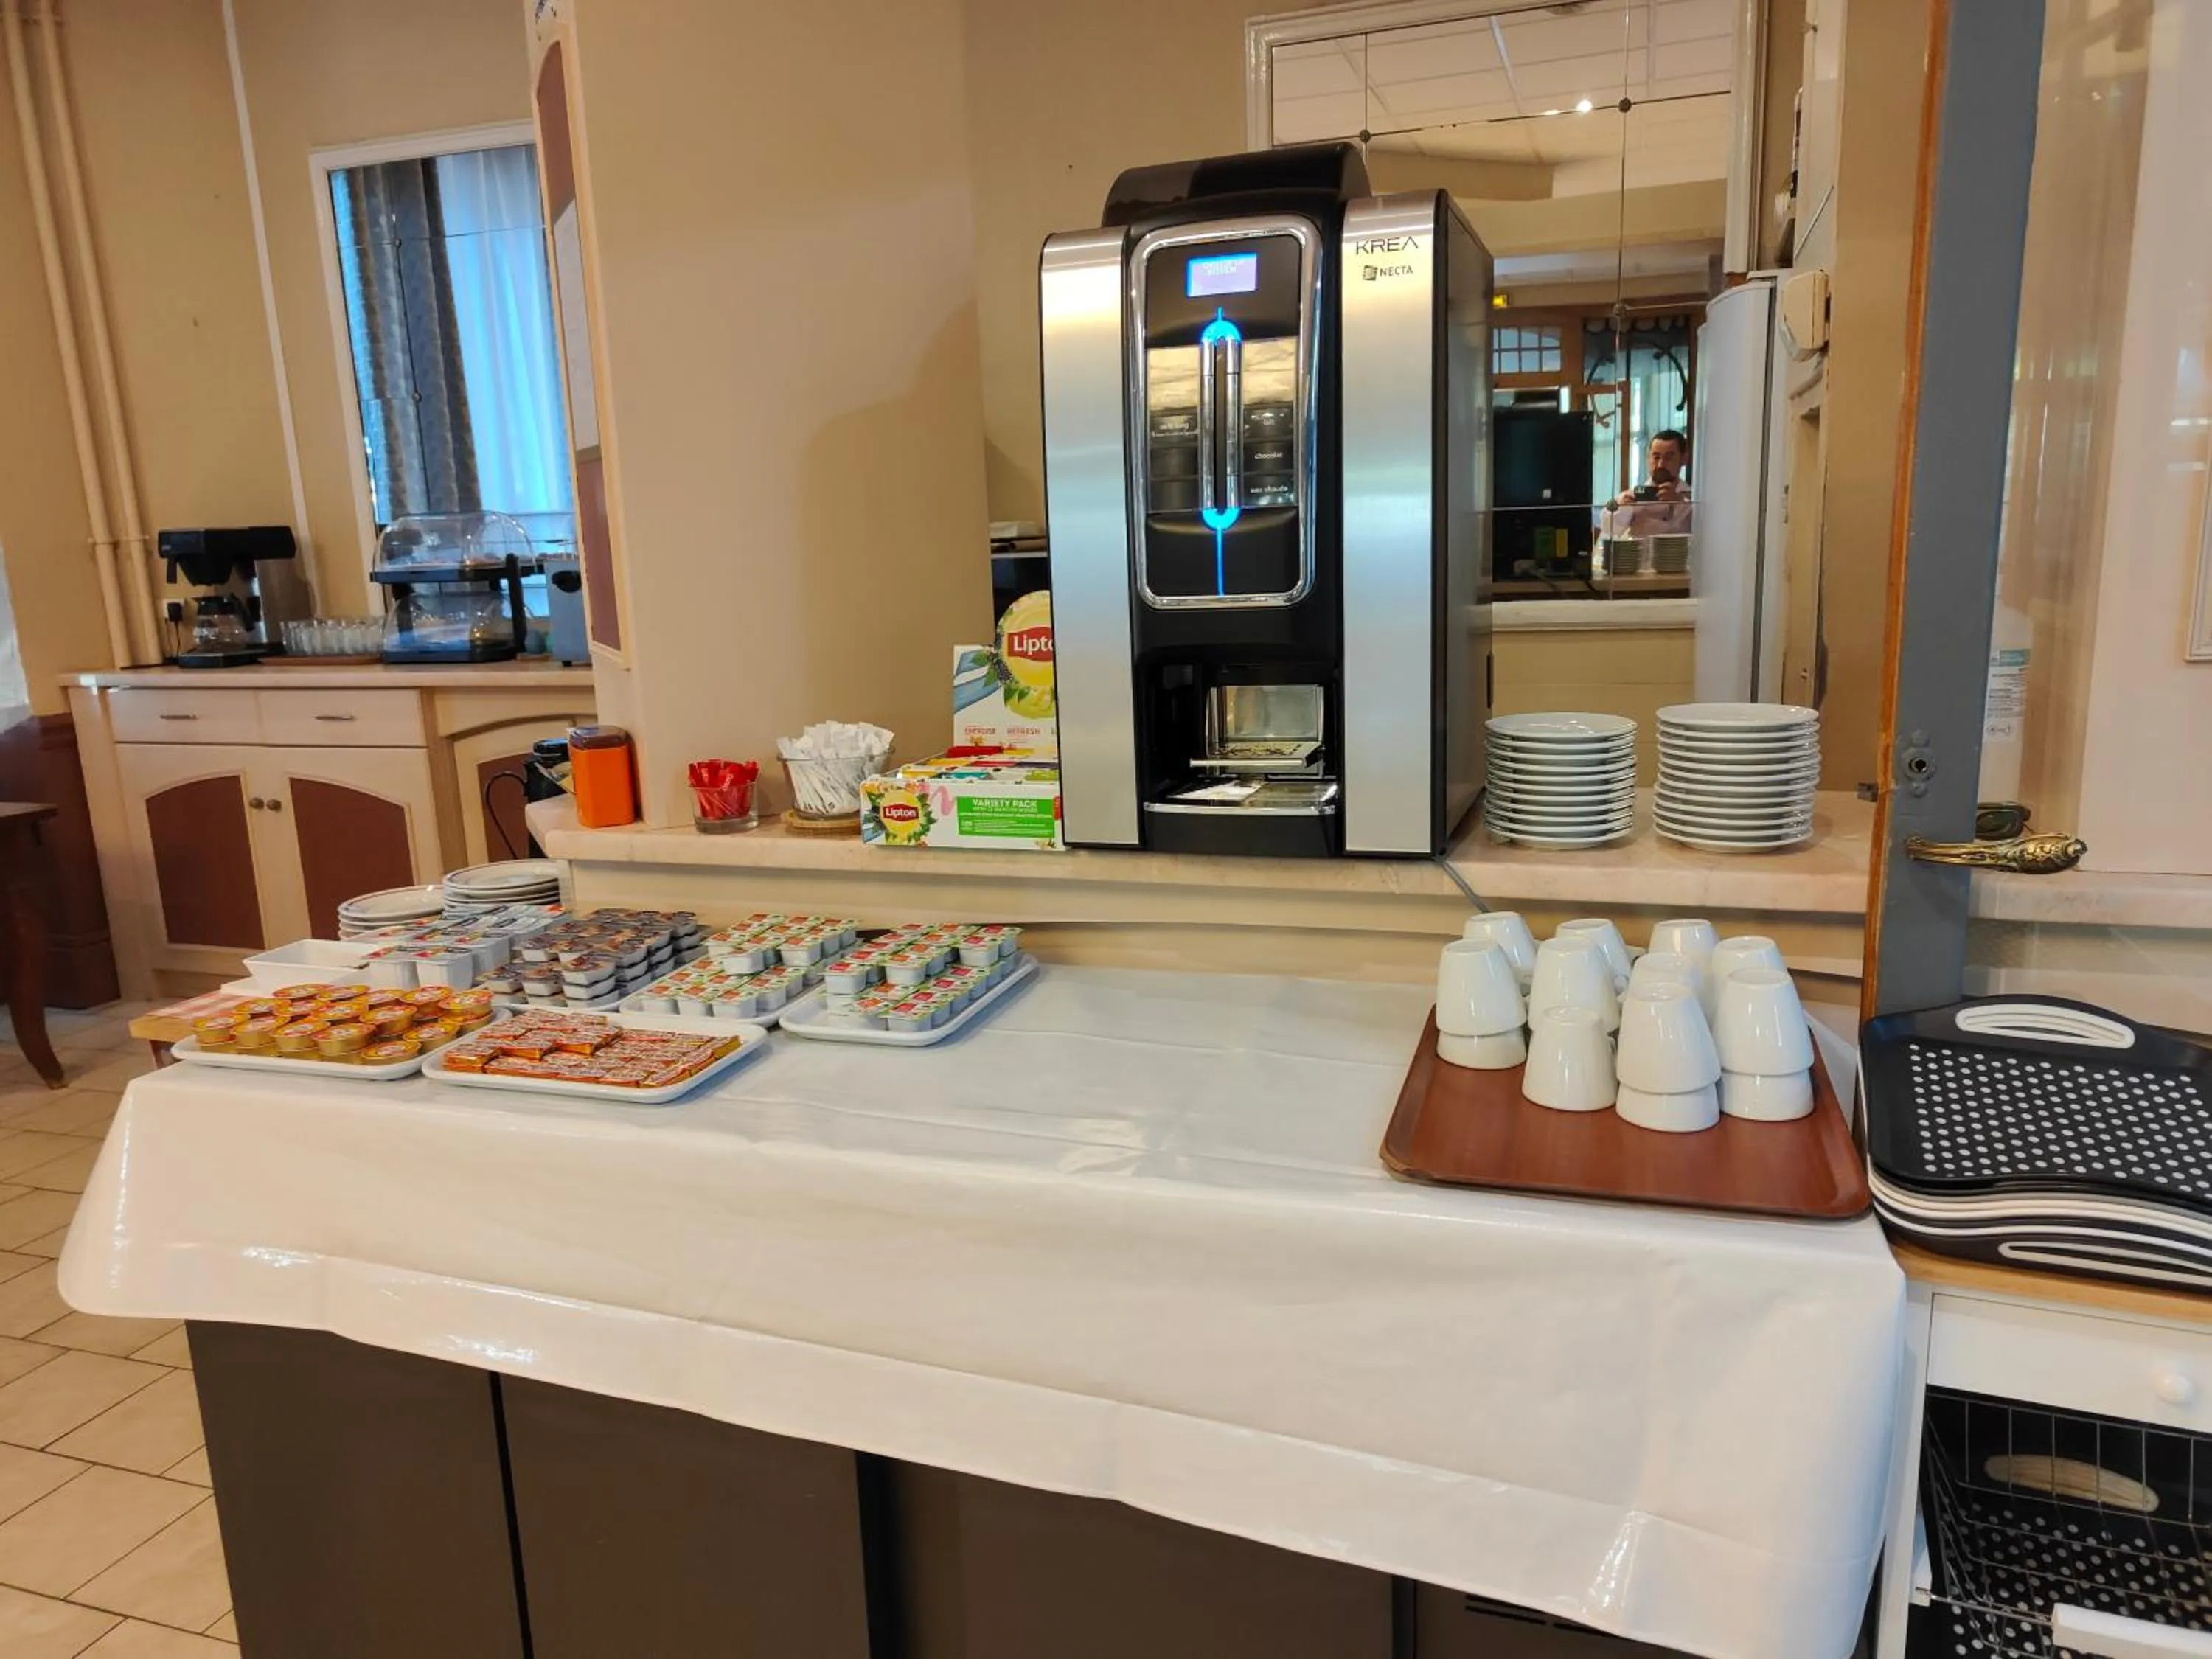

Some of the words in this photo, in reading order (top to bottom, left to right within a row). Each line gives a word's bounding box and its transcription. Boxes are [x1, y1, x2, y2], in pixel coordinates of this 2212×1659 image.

[1355, 235, 1419, 255] KREA
[1380, 265, 1413, 276] NECTA
[1012, 799, 1038, 808] PACK
[886, 807, 917, 818] Lipton
